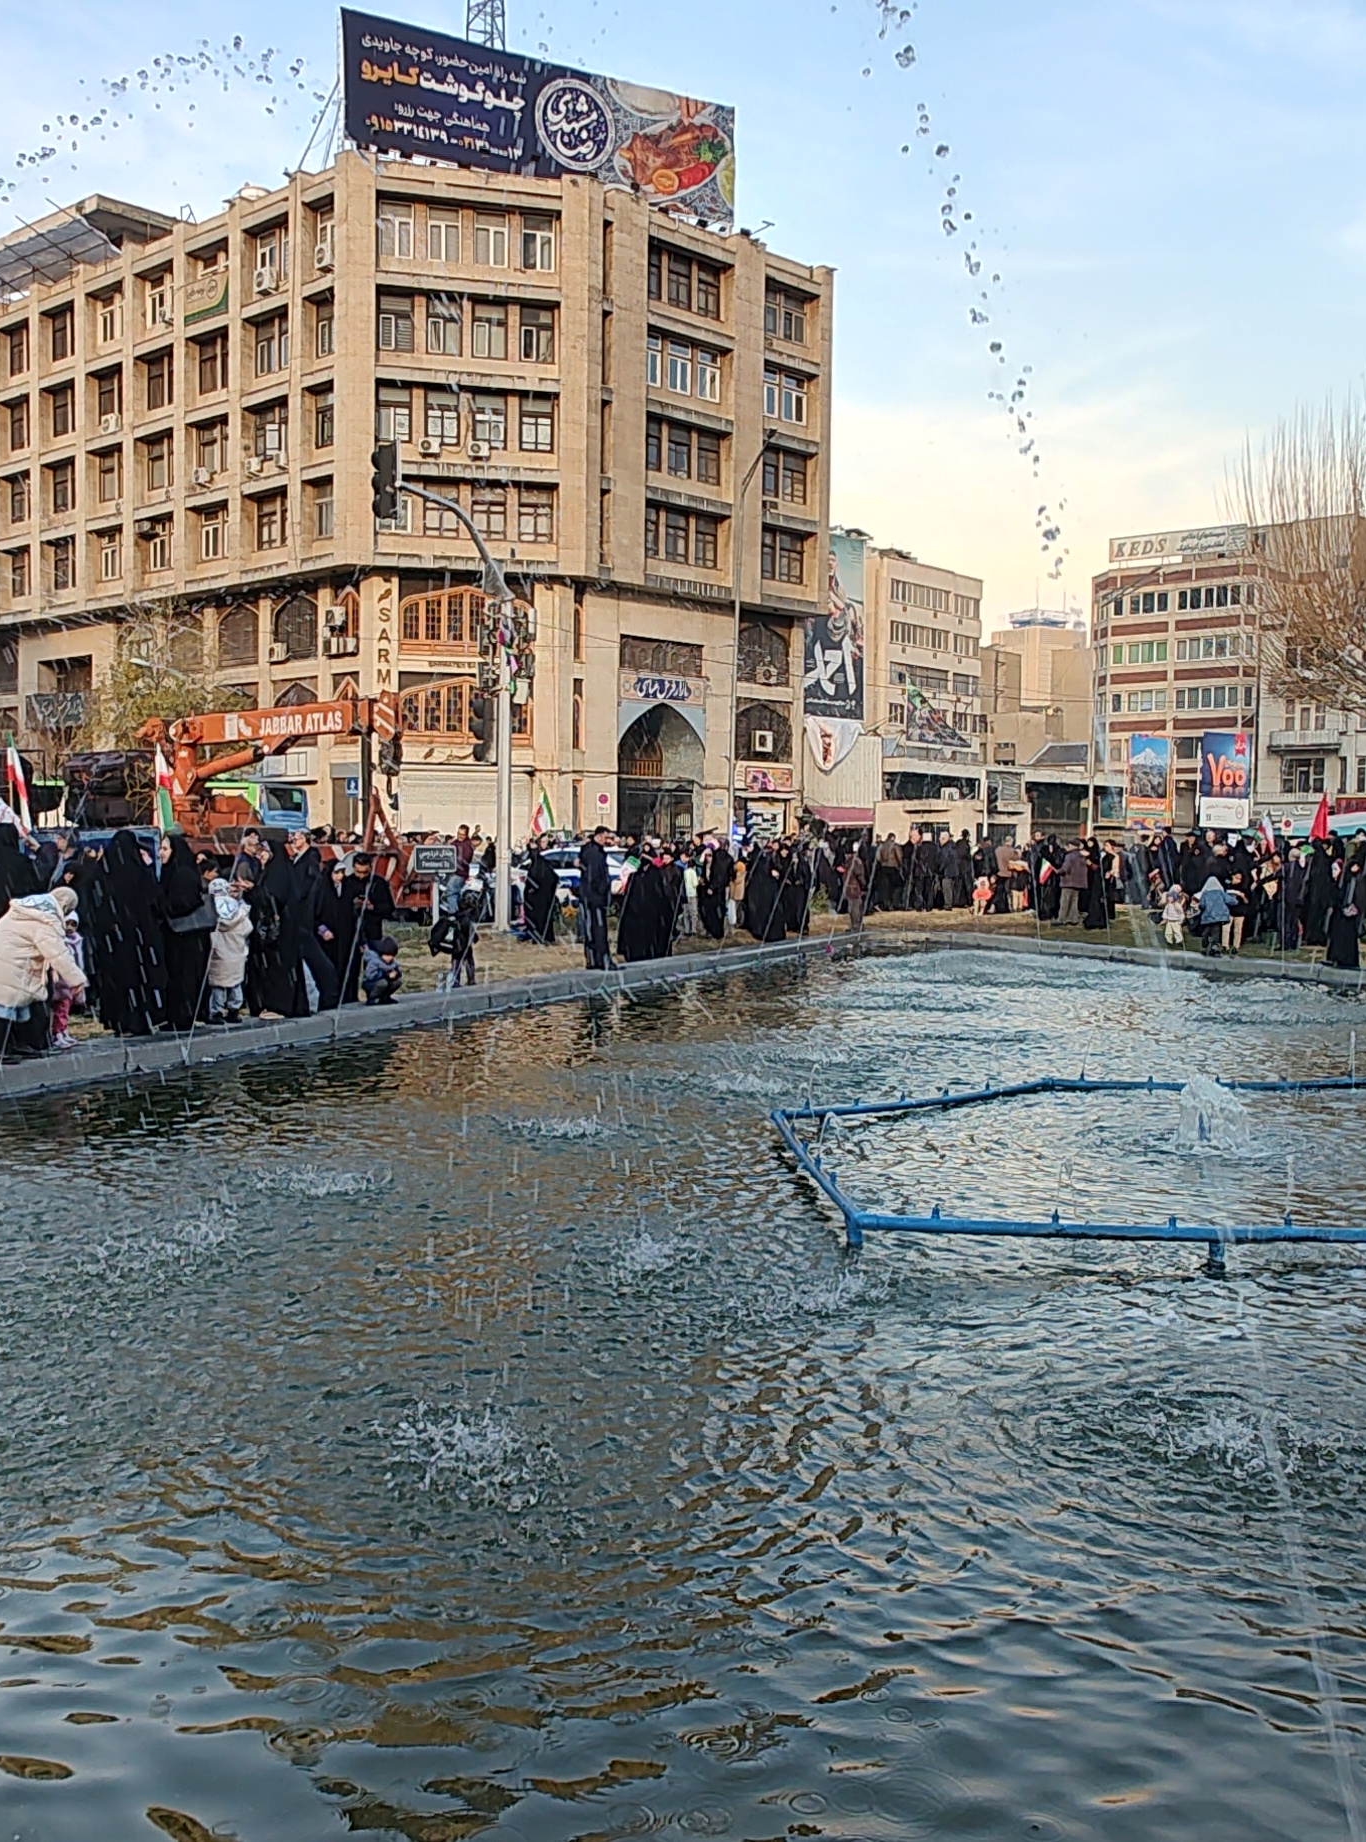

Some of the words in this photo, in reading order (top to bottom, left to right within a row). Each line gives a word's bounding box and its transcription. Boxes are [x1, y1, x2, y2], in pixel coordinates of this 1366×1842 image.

[405, 44, 434, 63] کوچه
[468, 62, 493, 75] امین
[419, 71, 526, 122] چلوگوشت
[416, 106, 442, 123] جهت
[444, 111, 491, 133] هماهنگی
[1114, 538, 1168, 558] KEDS
[259, 714, 303, 736] JABBAR
[305, 710, 343, 733] ATLAS
